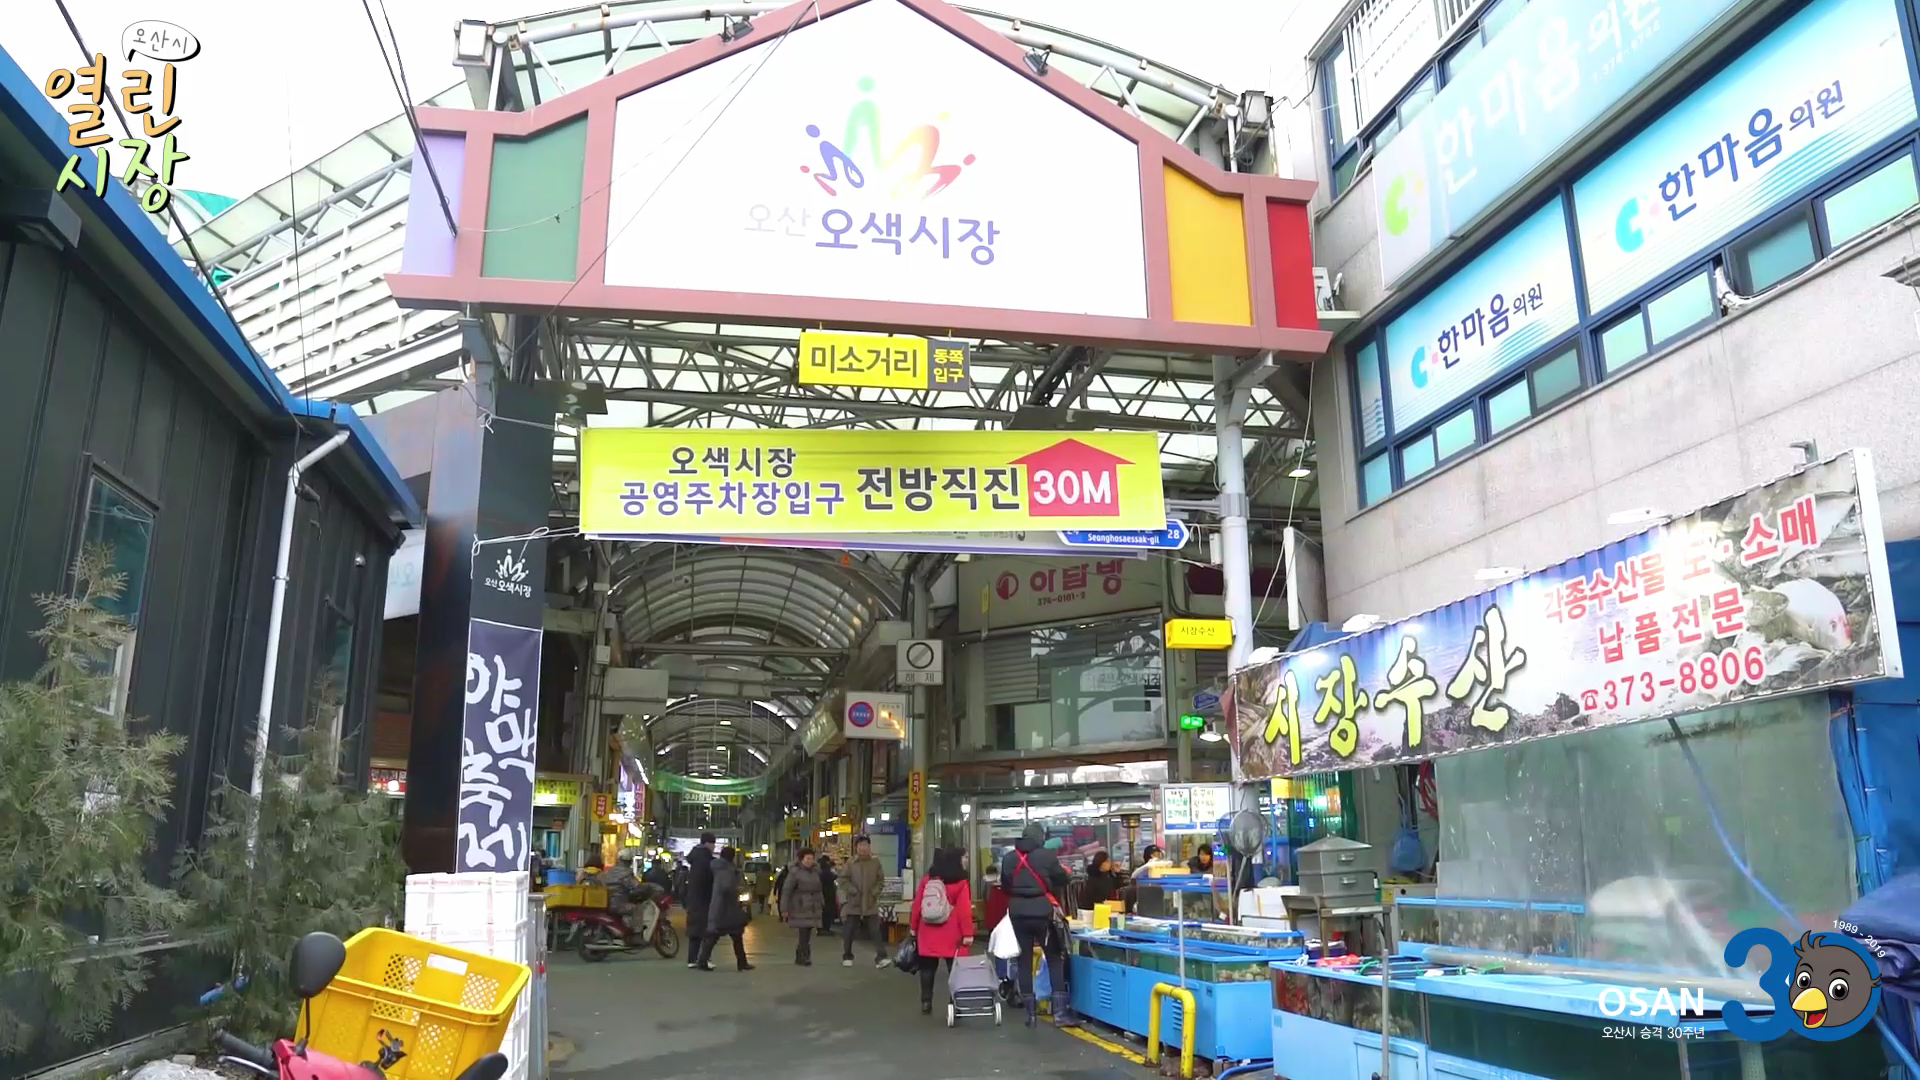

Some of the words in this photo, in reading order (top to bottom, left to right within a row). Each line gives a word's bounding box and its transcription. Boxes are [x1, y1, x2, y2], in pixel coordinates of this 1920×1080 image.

[1658, 80, 1845, 221] 한마음의원
[744, 203, 811, 238] 오산
[815, 208, 1000, 265] 오색시장
[1437, 282, 1544, 371] 한마음의원
[811, 344, 917, 378] 미소거리
[933, 348, 965, 368] 동쪽
[933, 367, 965, 384] 입구
[669, 446, 796, 478] 오색시장
[619, 481, 845, 516] 공영주차장입구
[857, 466, 1020, 511] 전방직진
[1032, 469, 1112, 505] 30M
[1087, 532, 1160, 545] Seonghosaessak-gil
[1167, 529, 1180, 540] 28
[484, 577, 498, 588] 오산
[497, 579, 532, 598] 오색시장
[1543, 552, 1666, 624] 각종수산물
[1264, 605, 1526, 766] 시장수산
[1603, 645, 1765, 711] 373-8806
